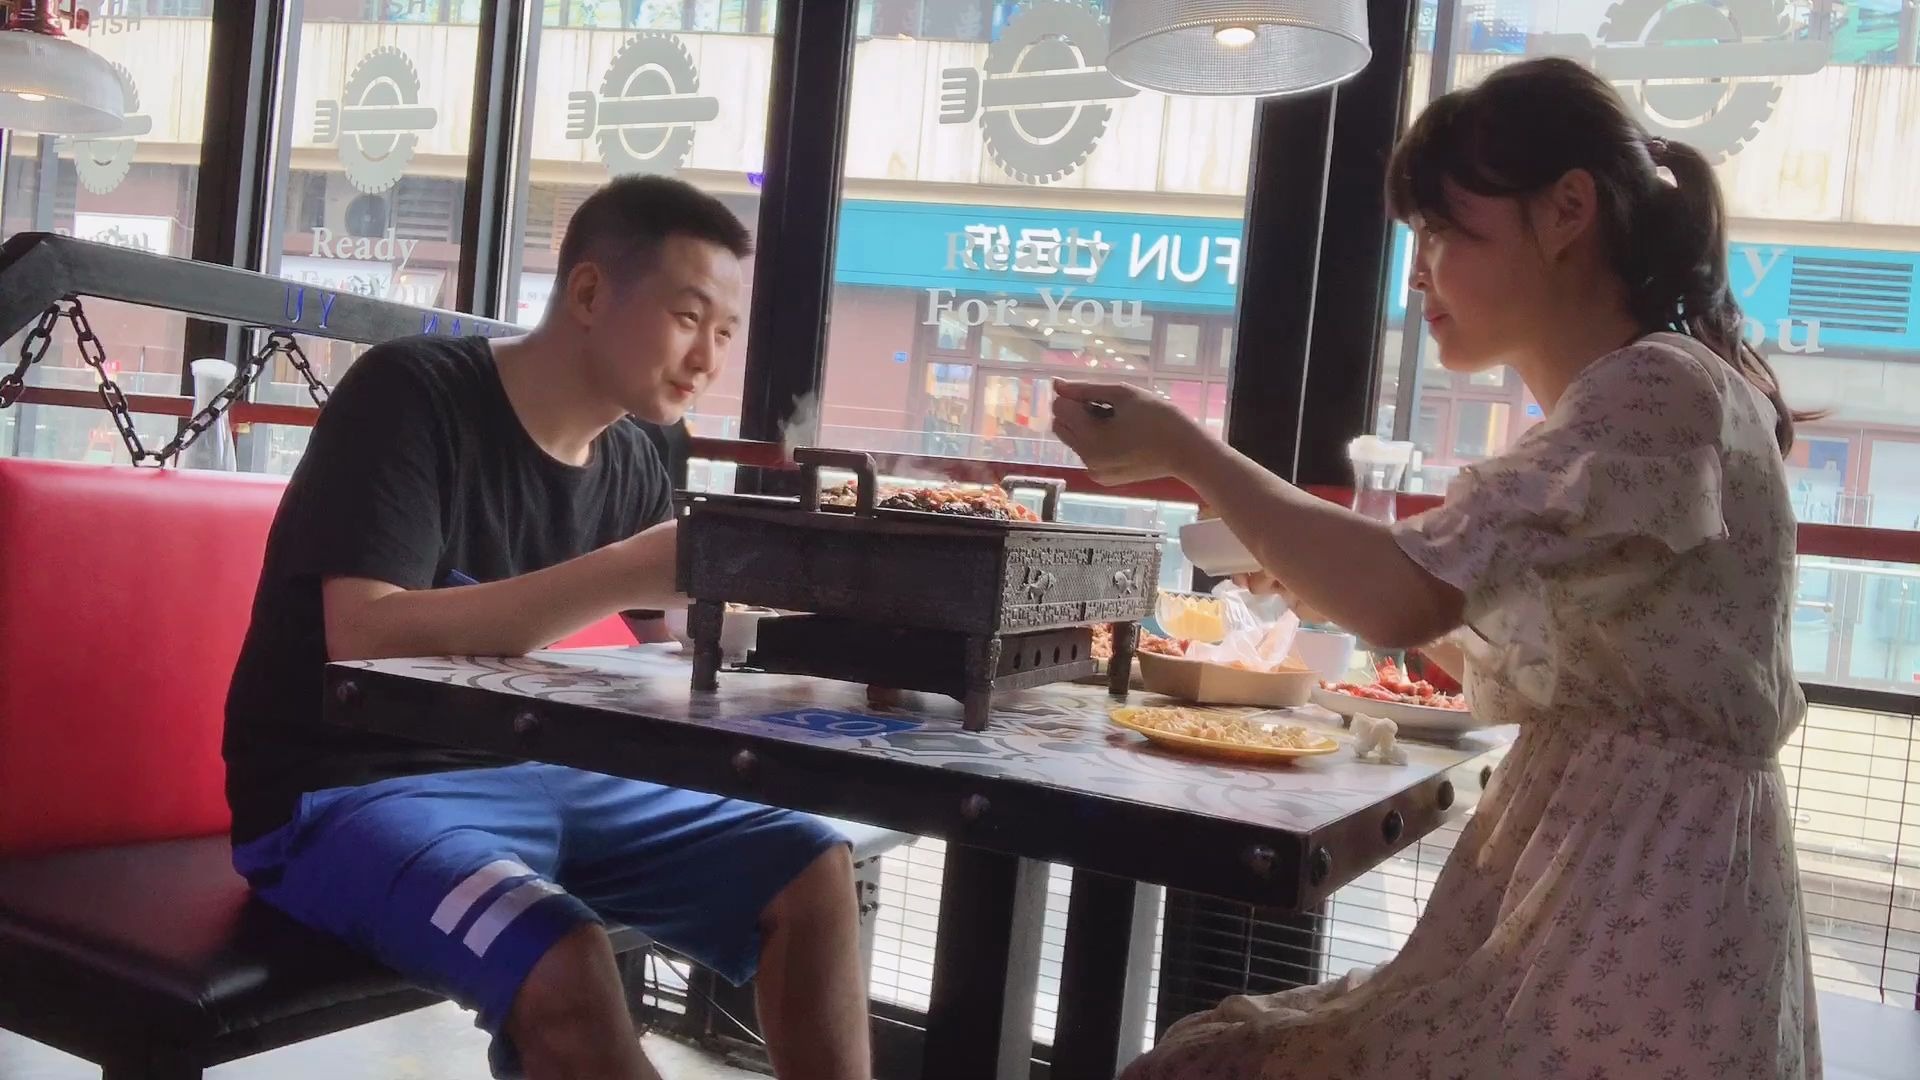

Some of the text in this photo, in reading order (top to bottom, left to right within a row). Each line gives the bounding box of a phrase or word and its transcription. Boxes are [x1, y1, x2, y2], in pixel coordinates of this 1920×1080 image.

[309, 227, 419, 272] Ready
[943, 228, 1117, 283] Ready
[922, 287, 1145, 329] For You
[1738, 317, 1824, 353] ou
